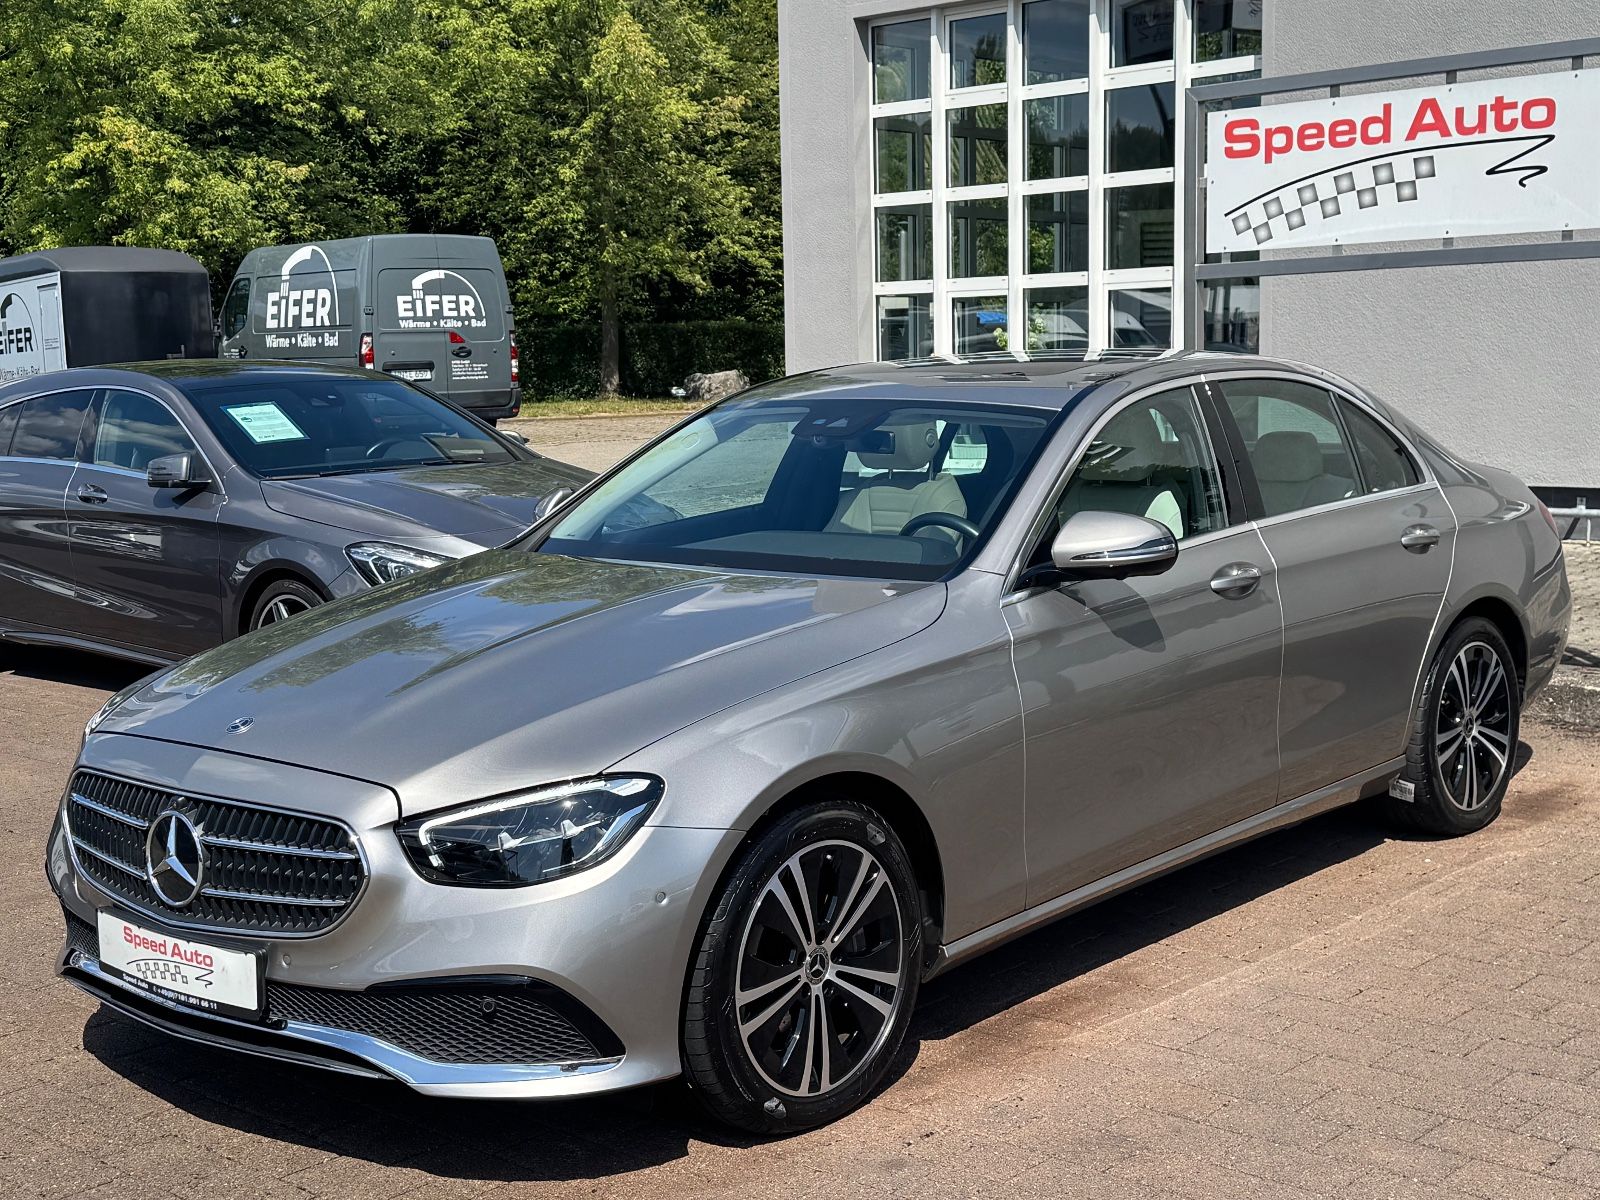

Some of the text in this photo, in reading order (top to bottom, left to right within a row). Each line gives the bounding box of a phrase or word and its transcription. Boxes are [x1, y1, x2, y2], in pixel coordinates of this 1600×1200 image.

[1224, 95, 1557, 164] Speed Auto
[399, 318, 487, 329] Wärme Kälte Bad
[265, 332, 339, 348] Wärme Kälte Bad
[123, 925, 214, 968] Speed Auto
[122, 973, 137, 985] Speed
